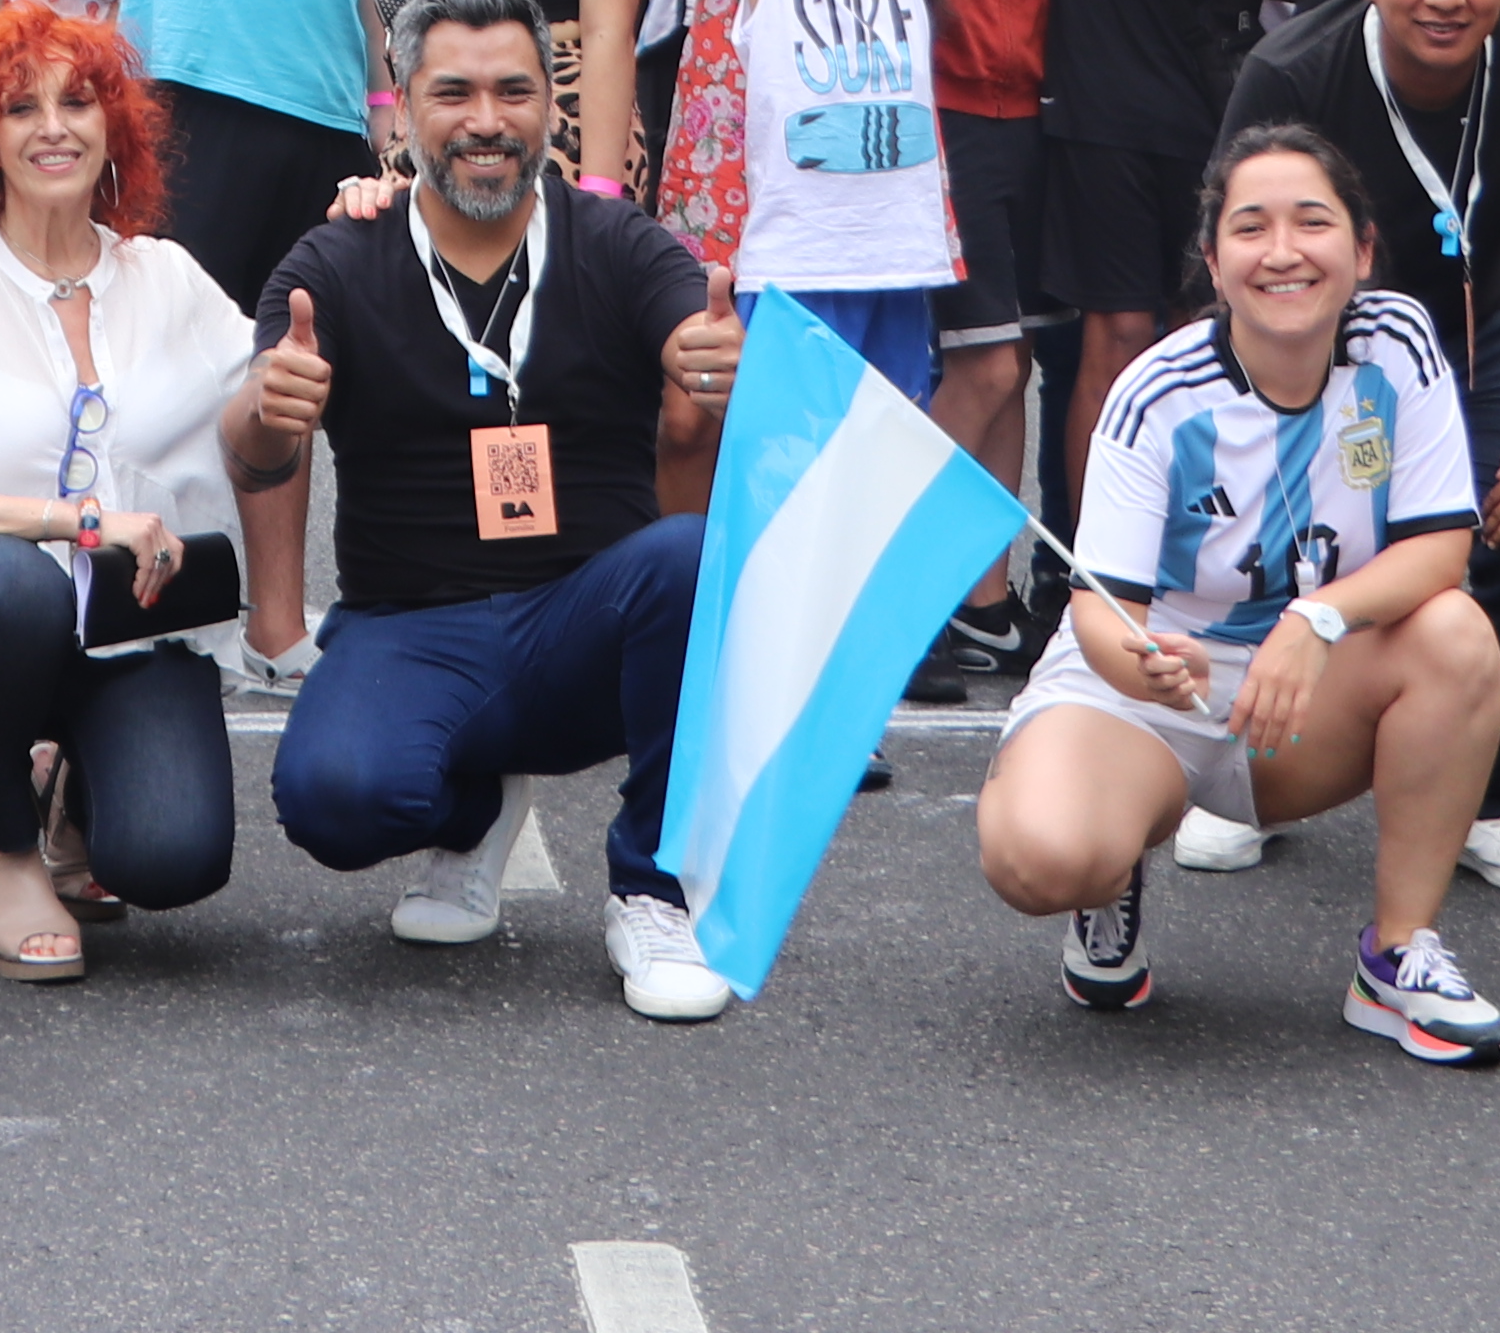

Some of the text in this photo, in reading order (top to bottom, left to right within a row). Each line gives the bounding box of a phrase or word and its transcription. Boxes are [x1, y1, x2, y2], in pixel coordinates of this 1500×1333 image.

[1352, 440, 1379, 468] AFA
[501, 501, 535, 520] BA
[1237, 526, 1340, 599] 10
